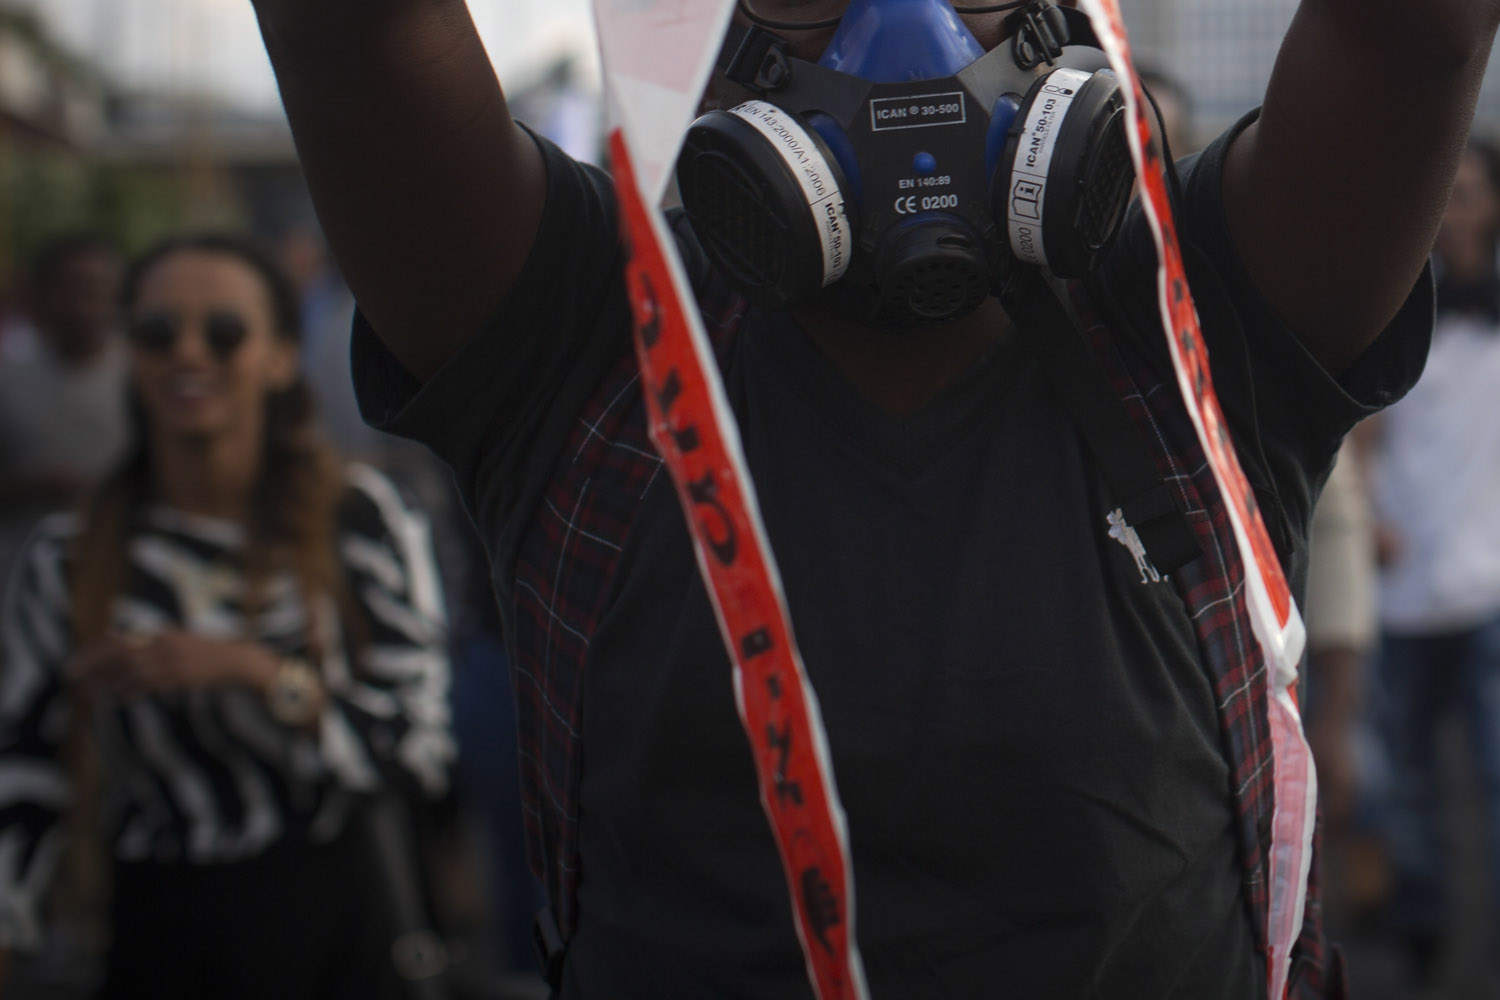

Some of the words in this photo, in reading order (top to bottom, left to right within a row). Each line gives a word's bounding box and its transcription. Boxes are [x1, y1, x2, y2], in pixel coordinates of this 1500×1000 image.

[876, 107, 907, 119] ICAN
[921, 103, 959, 115] 30-500
[1038, 98, 1056, 132] 50-103
[899, 179, 914, 188] EN
[917, 175, 951, 187] 140:89
[921, 194, 958, 210] 0200
